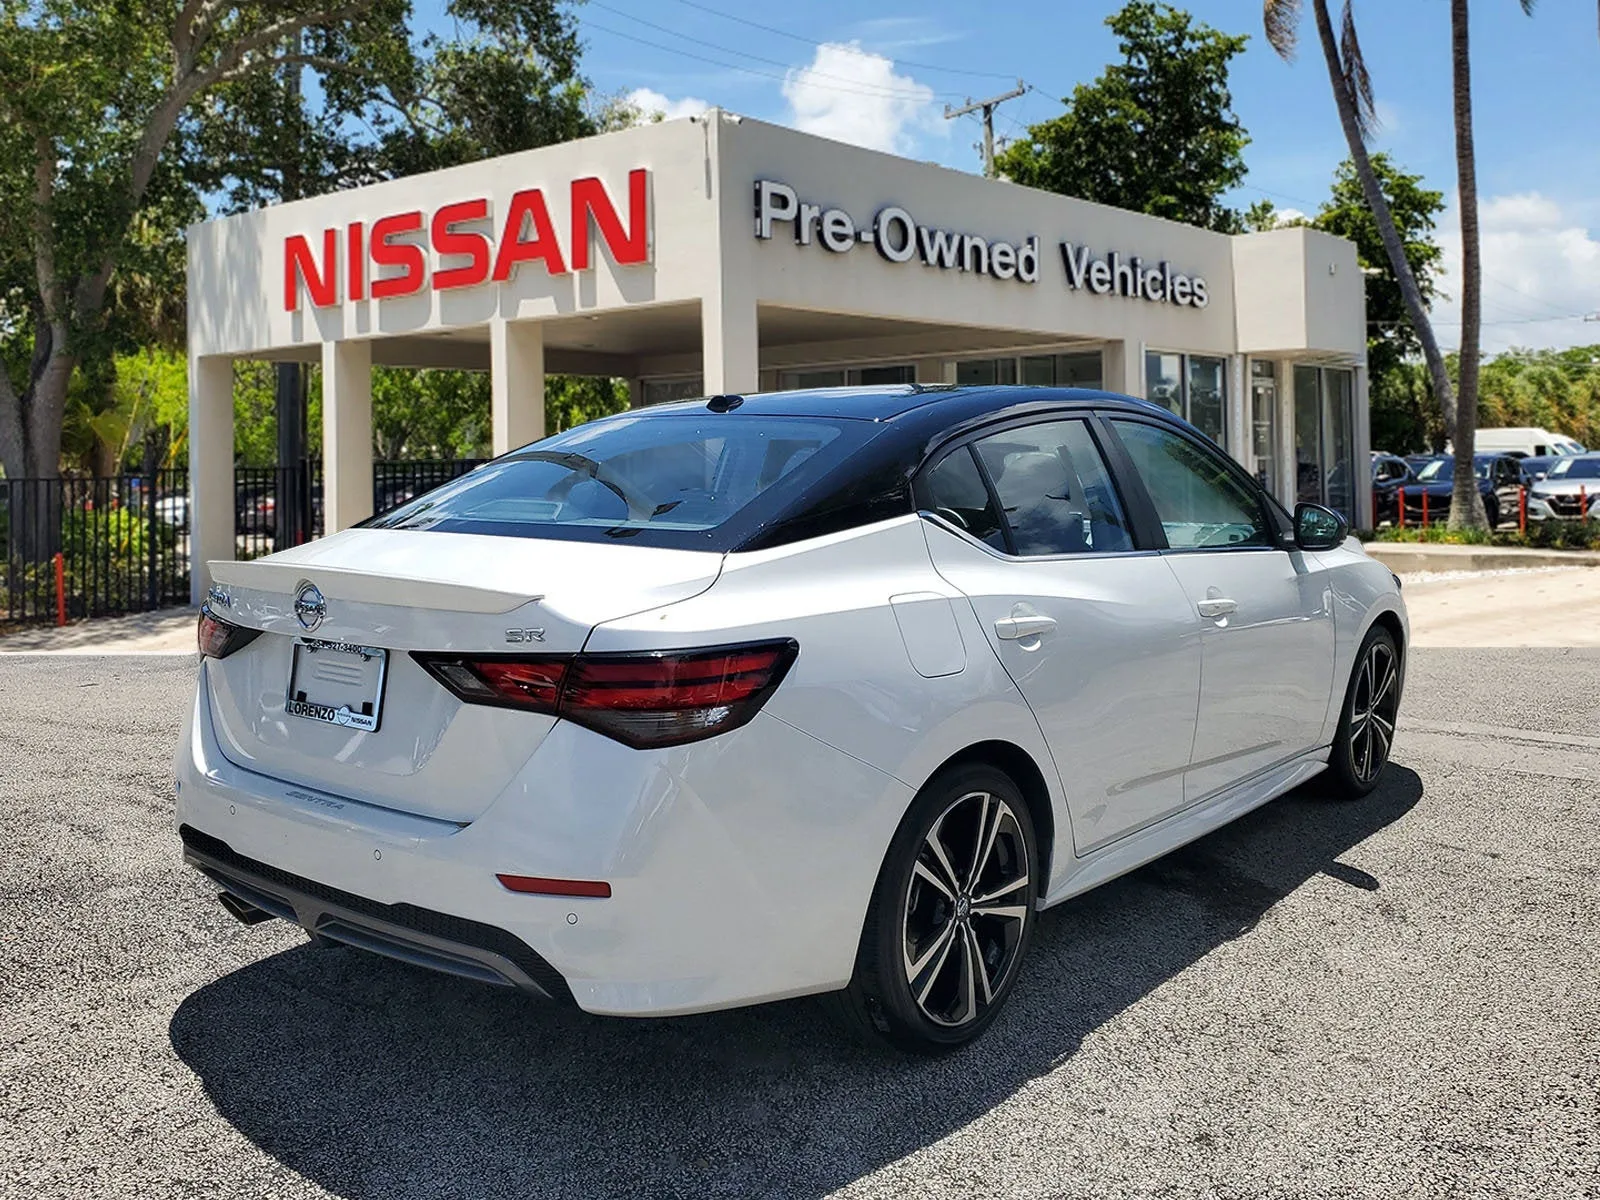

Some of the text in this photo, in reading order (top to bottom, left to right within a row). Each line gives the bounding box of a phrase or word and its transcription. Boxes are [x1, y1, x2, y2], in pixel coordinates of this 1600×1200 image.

[284, 168, 648, 312] NISSAN
[755, 180, 1210, 308] Pre-Owned Vehicles
[505, 627, 546, 643] SR
[288, 702, 336, 721] LORENZO
[351, 717, 372, 726] NISSAN
